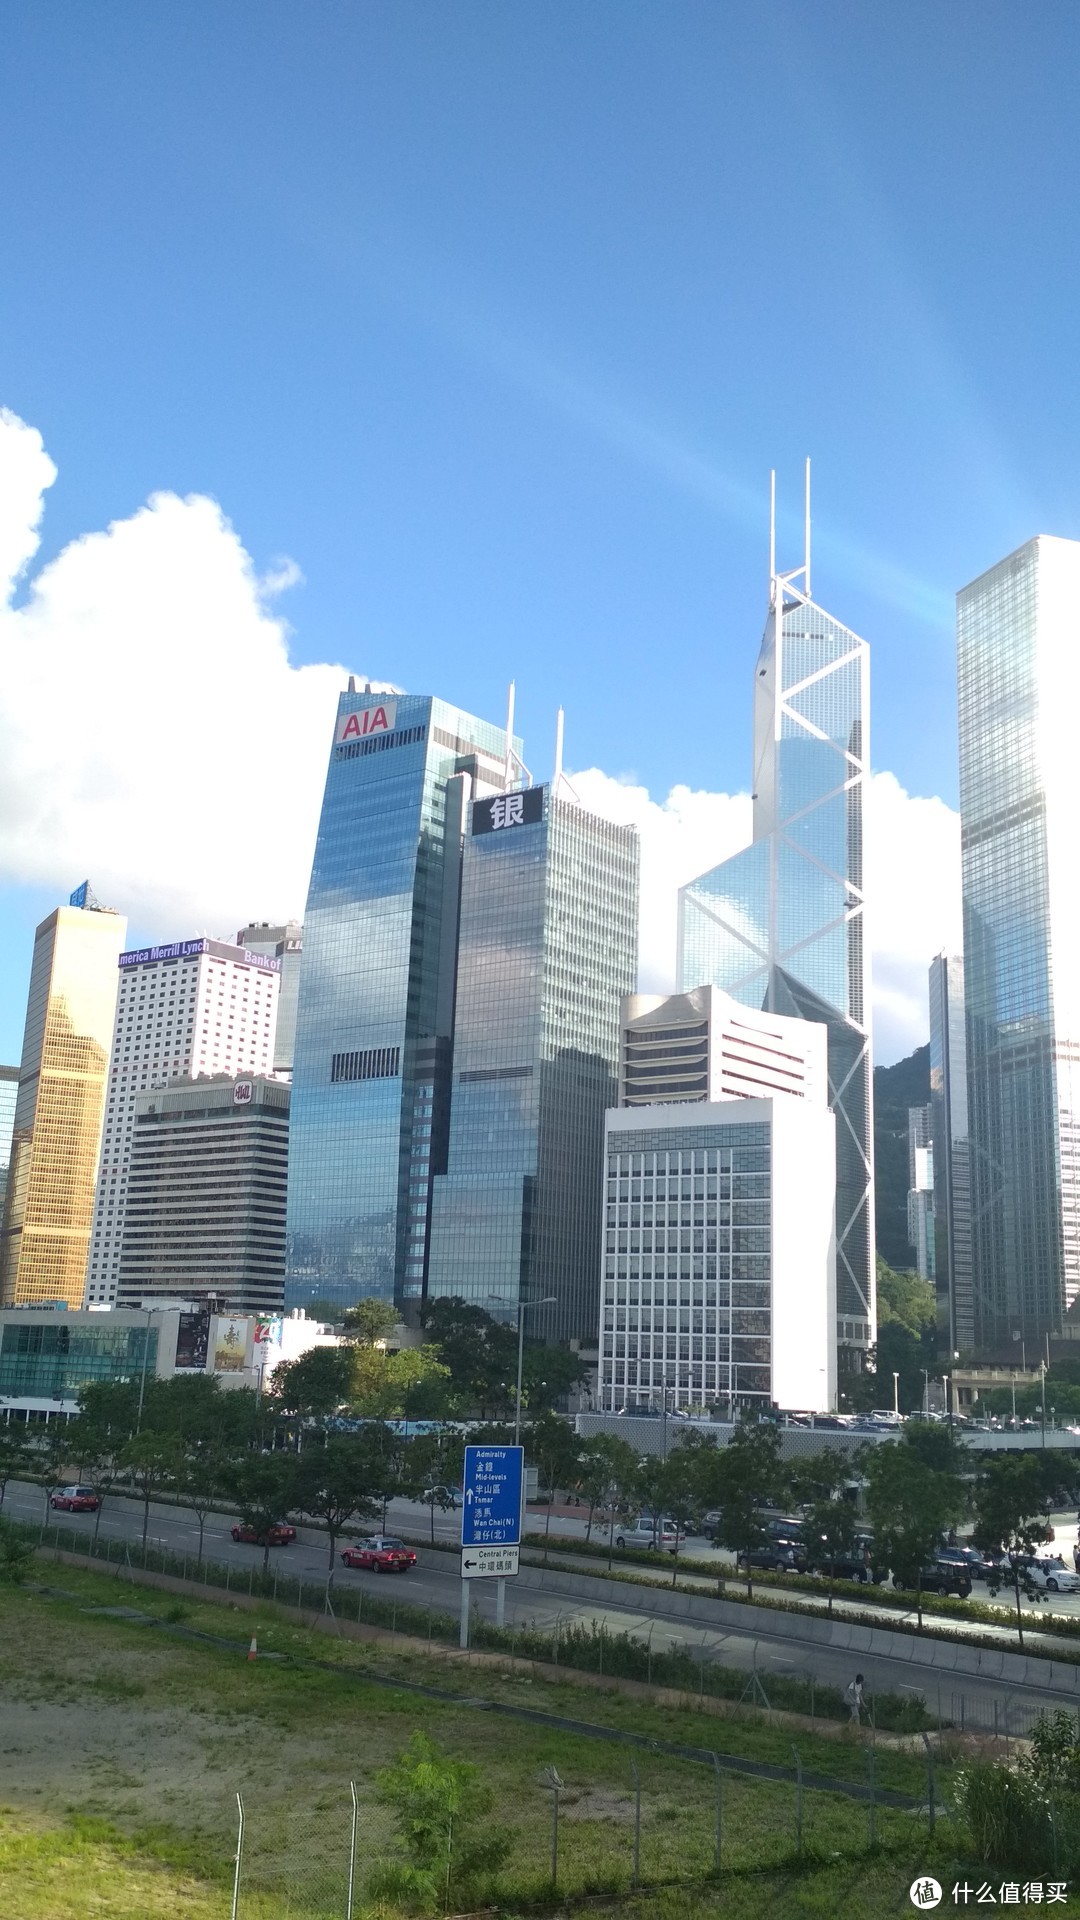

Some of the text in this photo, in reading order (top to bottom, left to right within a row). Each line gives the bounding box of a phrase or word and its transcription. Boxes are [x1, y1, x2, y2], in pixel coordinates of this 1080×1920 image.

[342, 706, 388, 740] AIA
[489, 794, 524, 830] 银
[118, 938, 210, 965] merica Merrill Lynch
[244, 950, 281, 970] Bank of
[476, 1450, 506, 1459] Admiralty
[475, 1461, 493, 1472] 金鐘
[475, 1473, 507, 1481] Mid-levels
[475, 1484, 501, 1494] 半山區
[474, 1496, 494, 1504] Tamar
[473, 1519, 487, 1527] Wan
[478, 1549, 518, 1558] Central Piers
[478, 1560, 513, 1572] 中環碼頭
